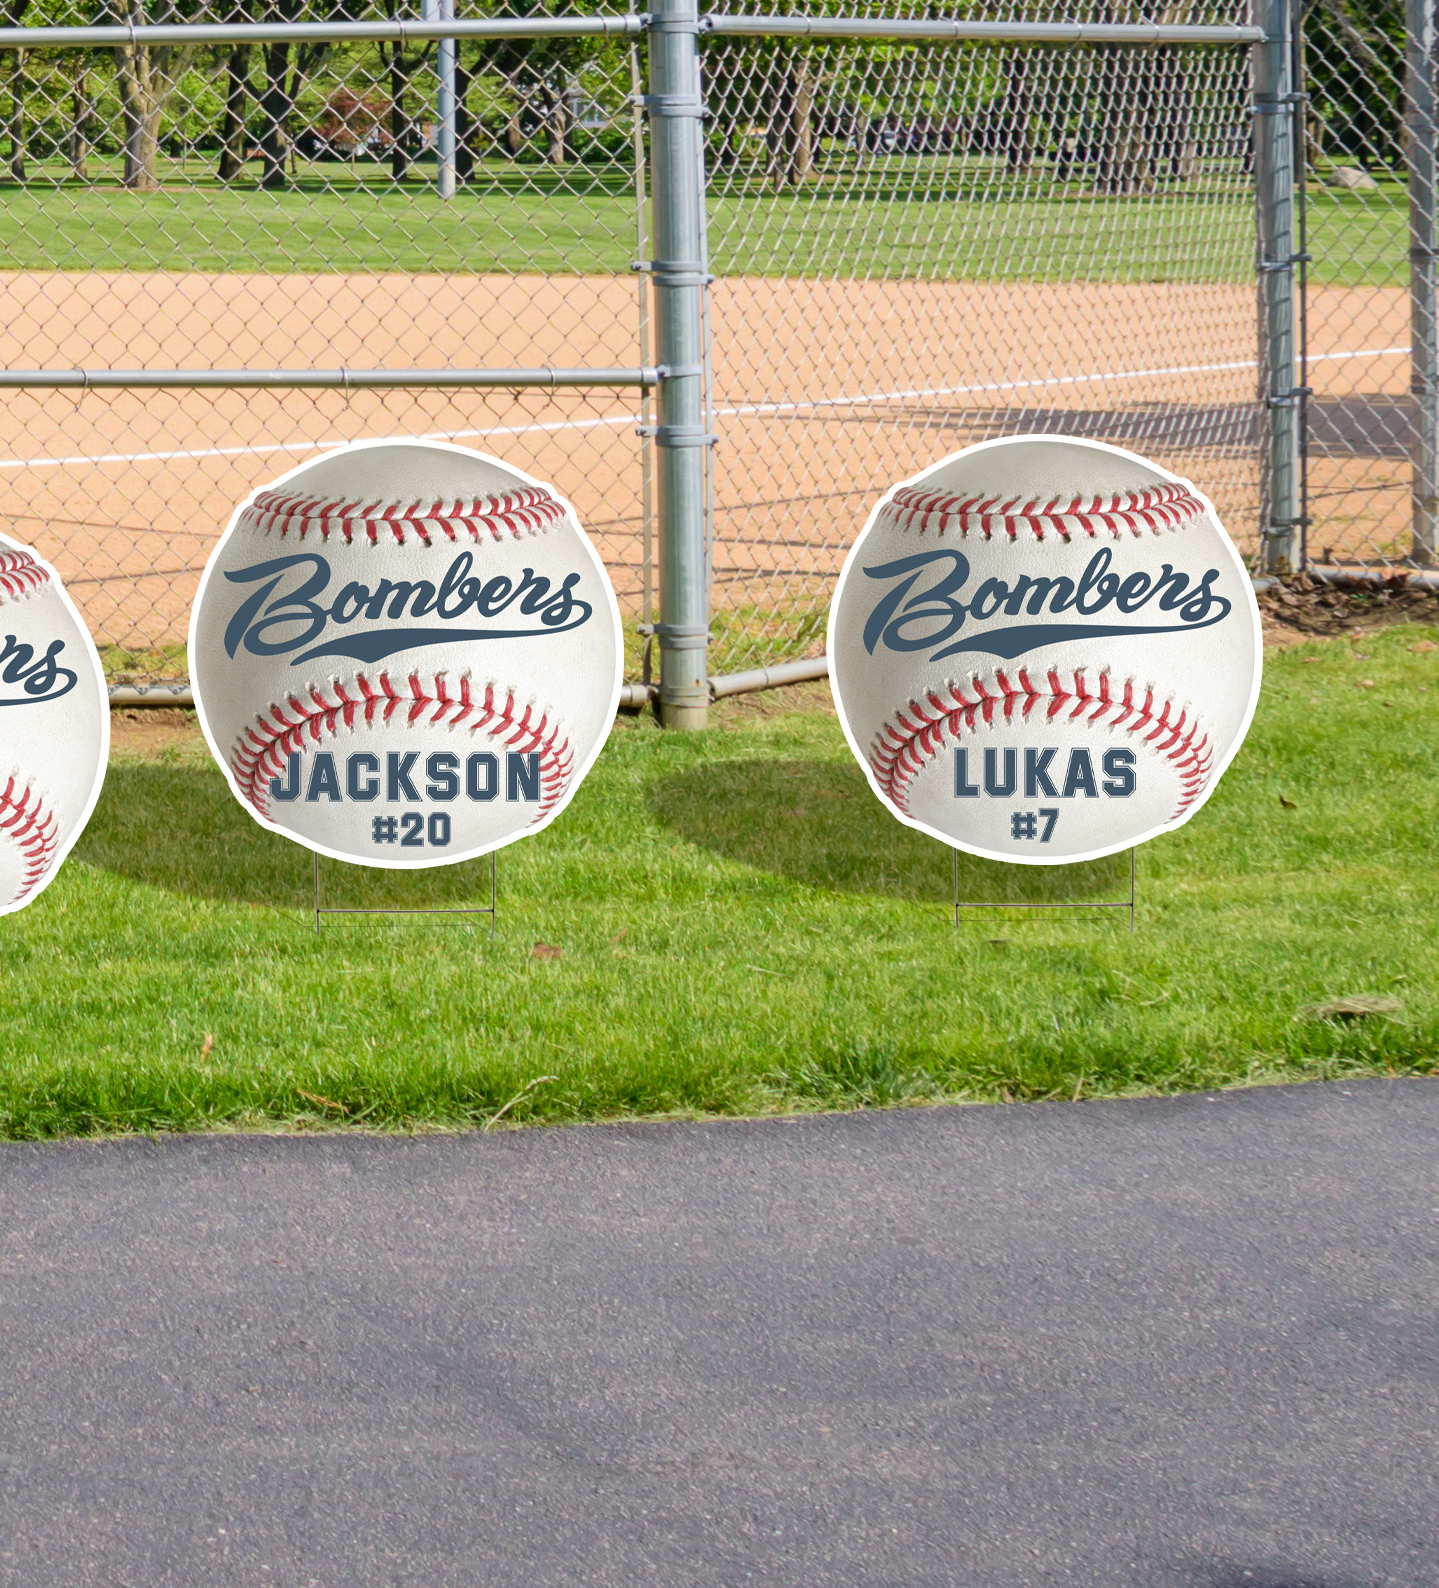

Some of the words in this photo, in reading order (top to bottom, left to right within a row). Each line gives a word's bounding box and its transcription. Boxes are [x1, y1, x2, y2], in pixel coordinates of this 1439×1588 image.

[223, 551, 592, 666] Bombers
[862, 547, 1231, 662] Bombers
[269, 751, 541, 803] JACKSON
[953, 747, 1137, 798] LUKAS
[372, 811, 452, 847] #20
[1011, 808, 1059, 843] #7
